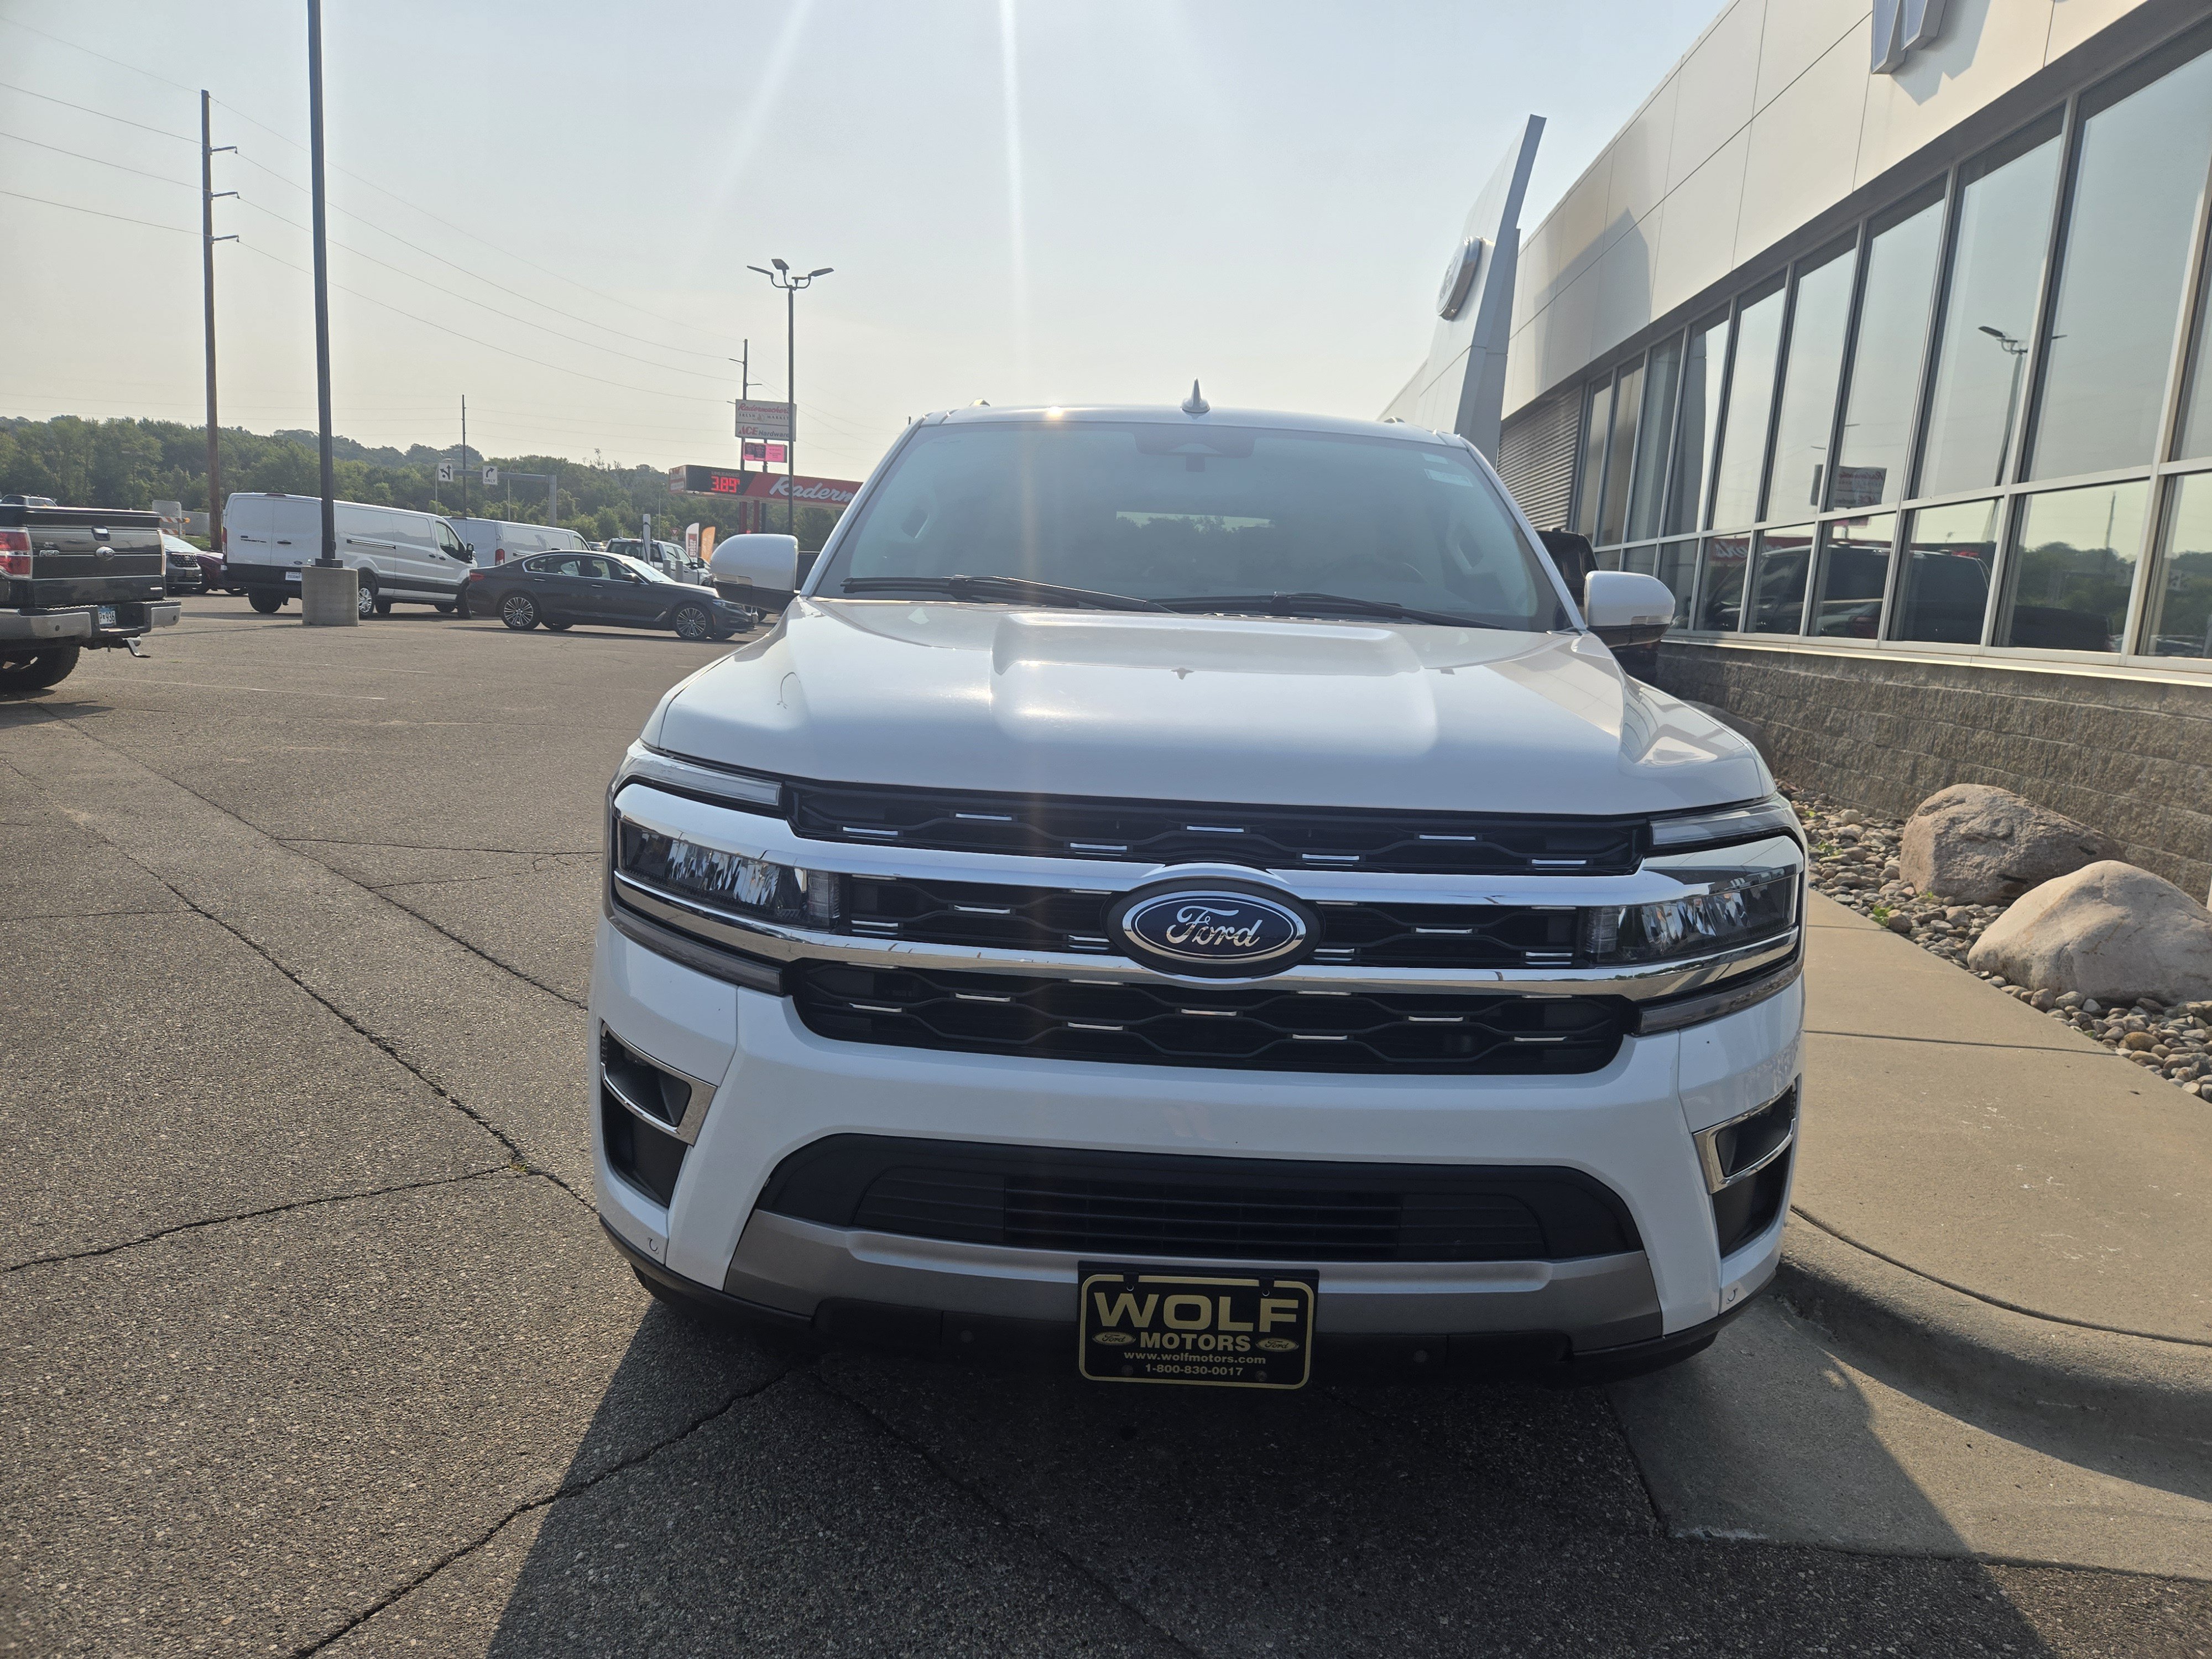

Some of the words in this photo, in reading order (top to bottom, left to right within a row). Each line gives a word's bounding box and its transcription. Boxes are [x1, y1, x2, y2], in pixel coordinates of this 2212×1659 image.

[738, 425, 758, 435] ACE
[1166, 905, 1263, 947] Ford
[1094, 1292, 1299, 1332] WOLF
[1140, 1332, 1251, 1352] MOTORS
[1124, 1352, 1266, 1364] www.wolfmotors.com
[1145, 1364, 1244, 1376] 1-800-830-0017
